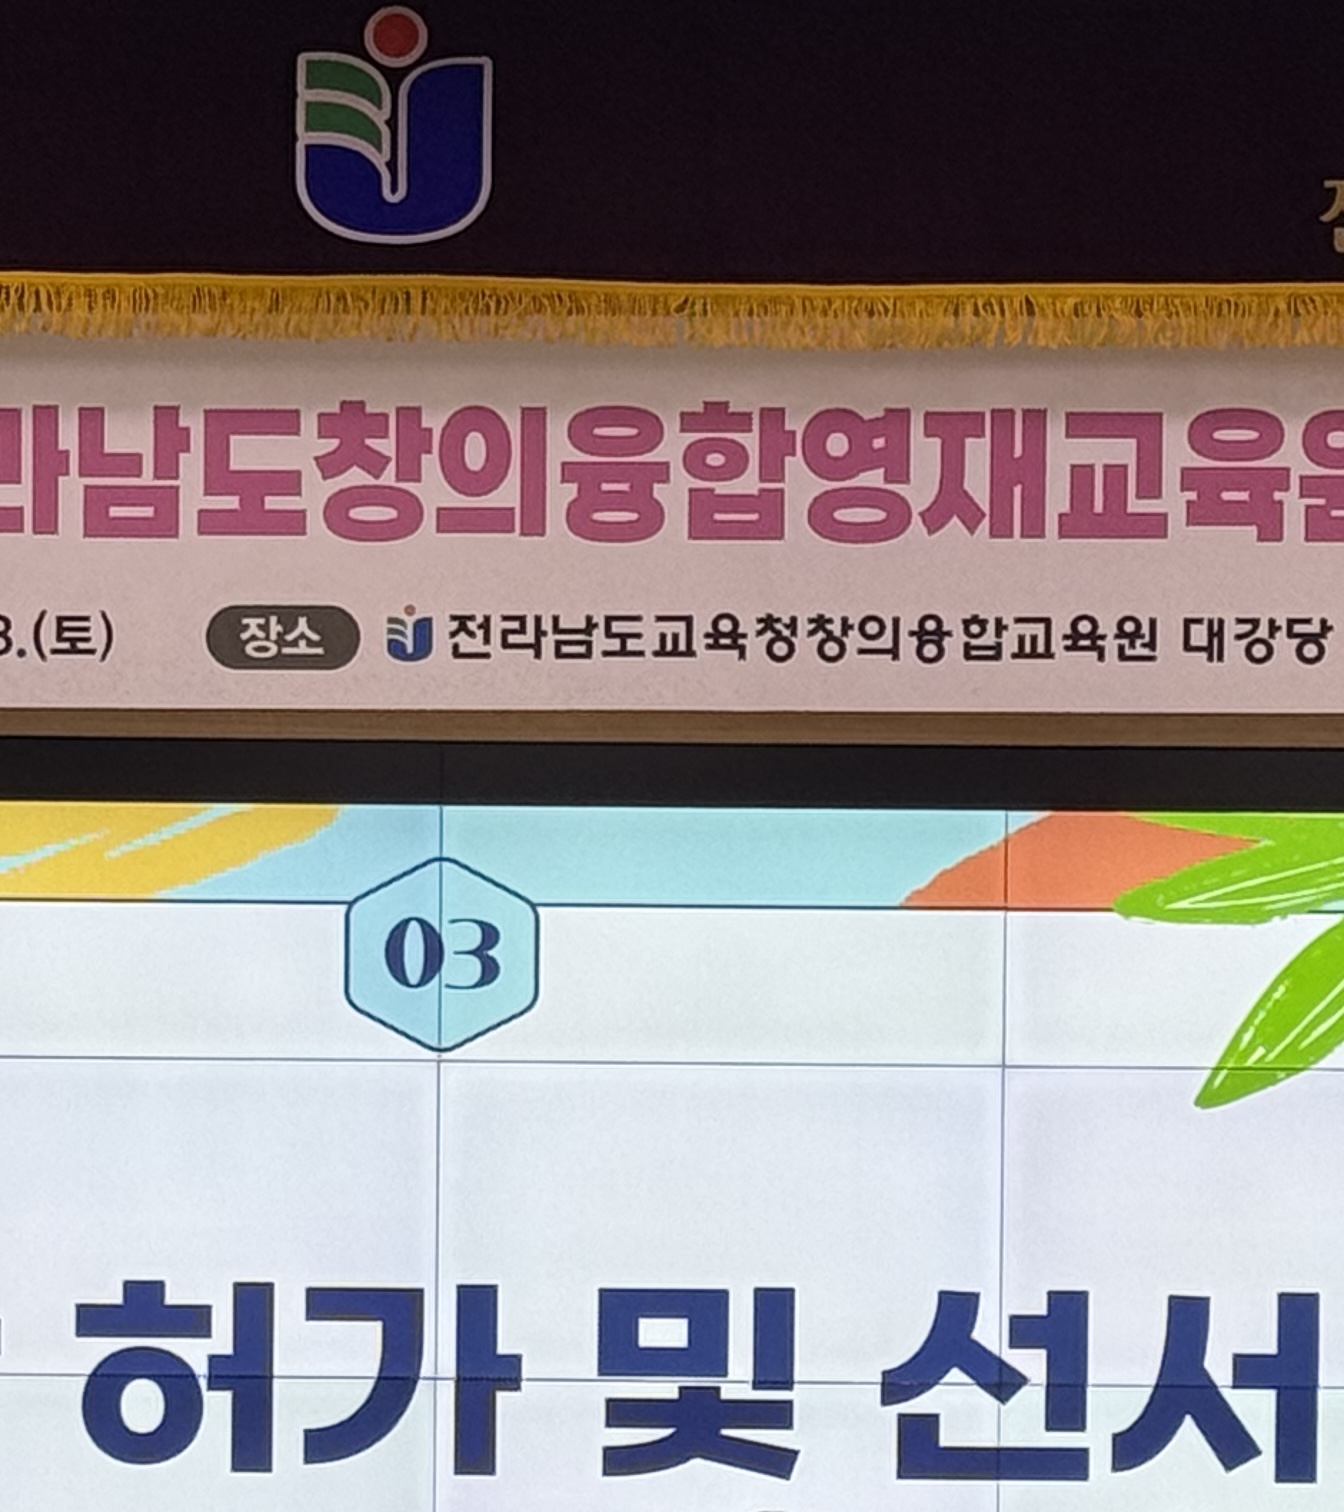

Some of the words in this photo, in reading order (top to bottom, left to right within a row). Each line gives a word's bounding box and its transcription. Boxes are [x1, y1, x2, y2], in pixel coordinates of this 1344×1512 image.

[238, 615, 326, 659] 장소
[447, 611, 1161, 665] 전라남도교육청창의융합교육원
[1181, 614, 1335, 666] 대강당
[384, 915, 502, 990] 03
[74, 1279, 524, 1476] 허가
[597, 1287, 801, 1481] 및
[880, 1289, 1321, 1484] 선서
